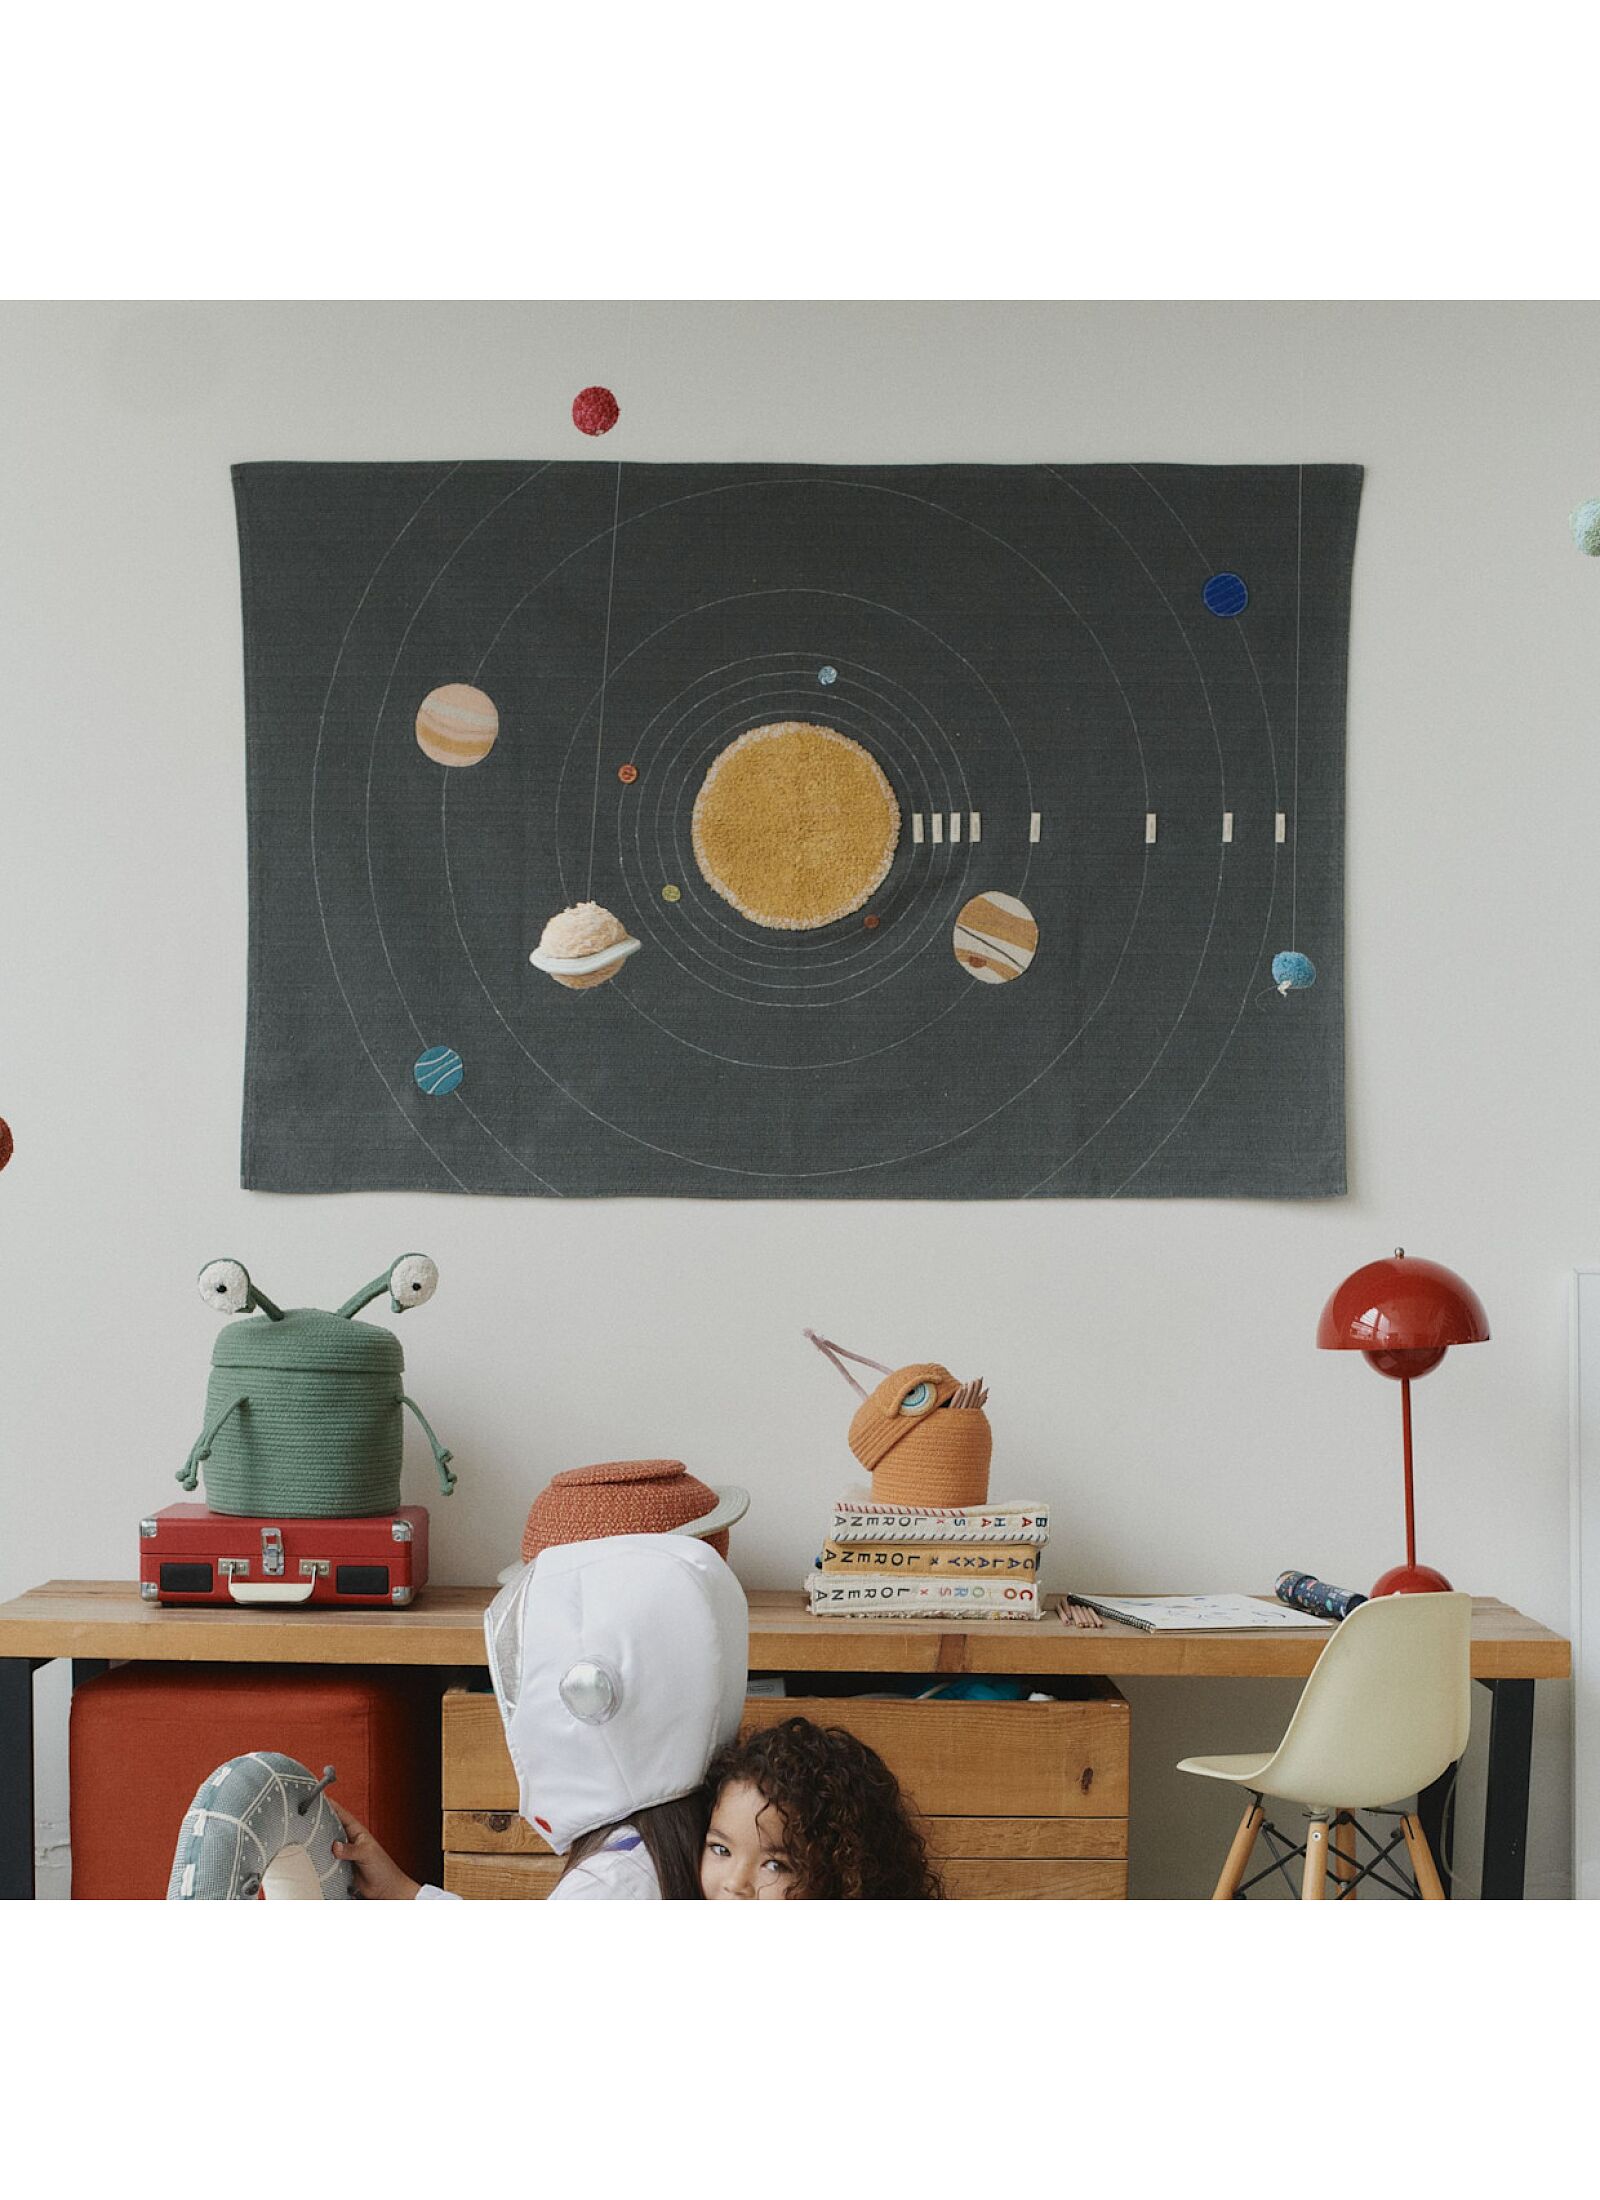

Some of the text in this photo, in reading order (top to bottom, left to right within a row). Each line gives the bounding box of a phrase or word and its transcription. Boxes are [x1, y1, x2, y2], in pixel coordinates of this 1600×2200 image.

[834, 1516, 928, 1527] LORENA
[954, 1517, 1048, 1528] BAHAS
[824, 1549, 920, 1567] LORENA
[947, 1556, 1034, 1569] GALAXY
[815, 1587, 911, 1602] LORENA
